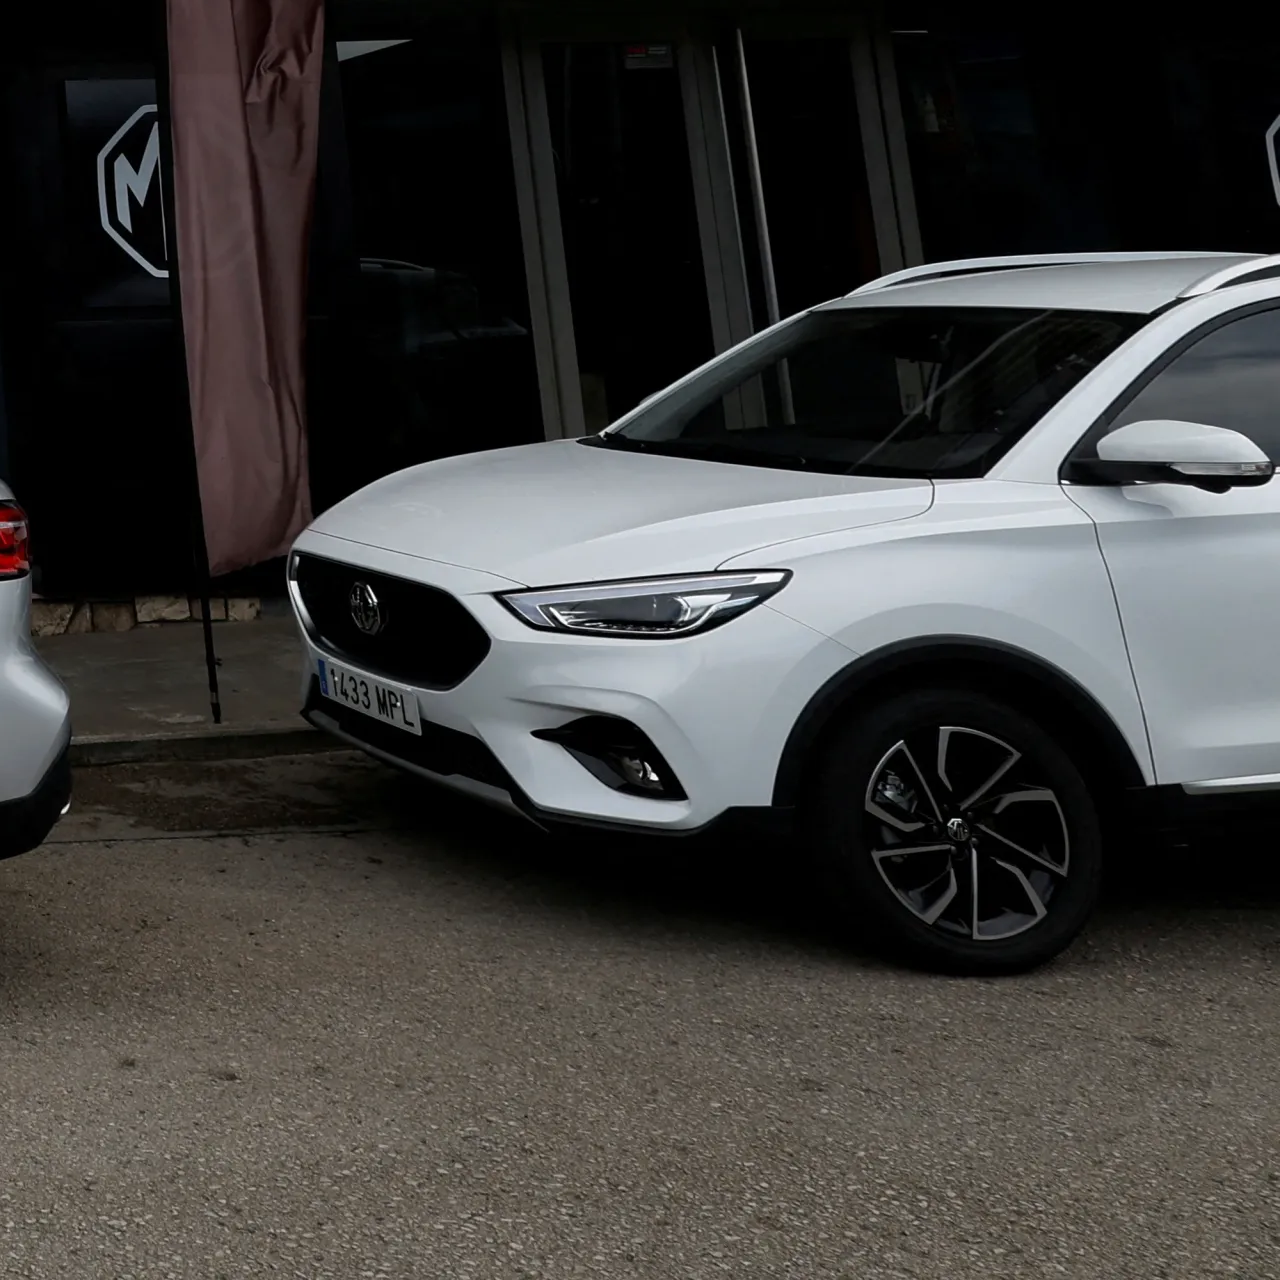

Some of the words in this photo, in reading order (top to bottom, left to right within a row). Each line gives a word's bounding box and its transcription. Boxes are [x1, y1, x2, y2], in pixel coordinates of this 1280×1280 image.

[114, 121, 167, 261] M
[330, 668, 371, 710] 1433
[375, 684, 415, 728] MPL
